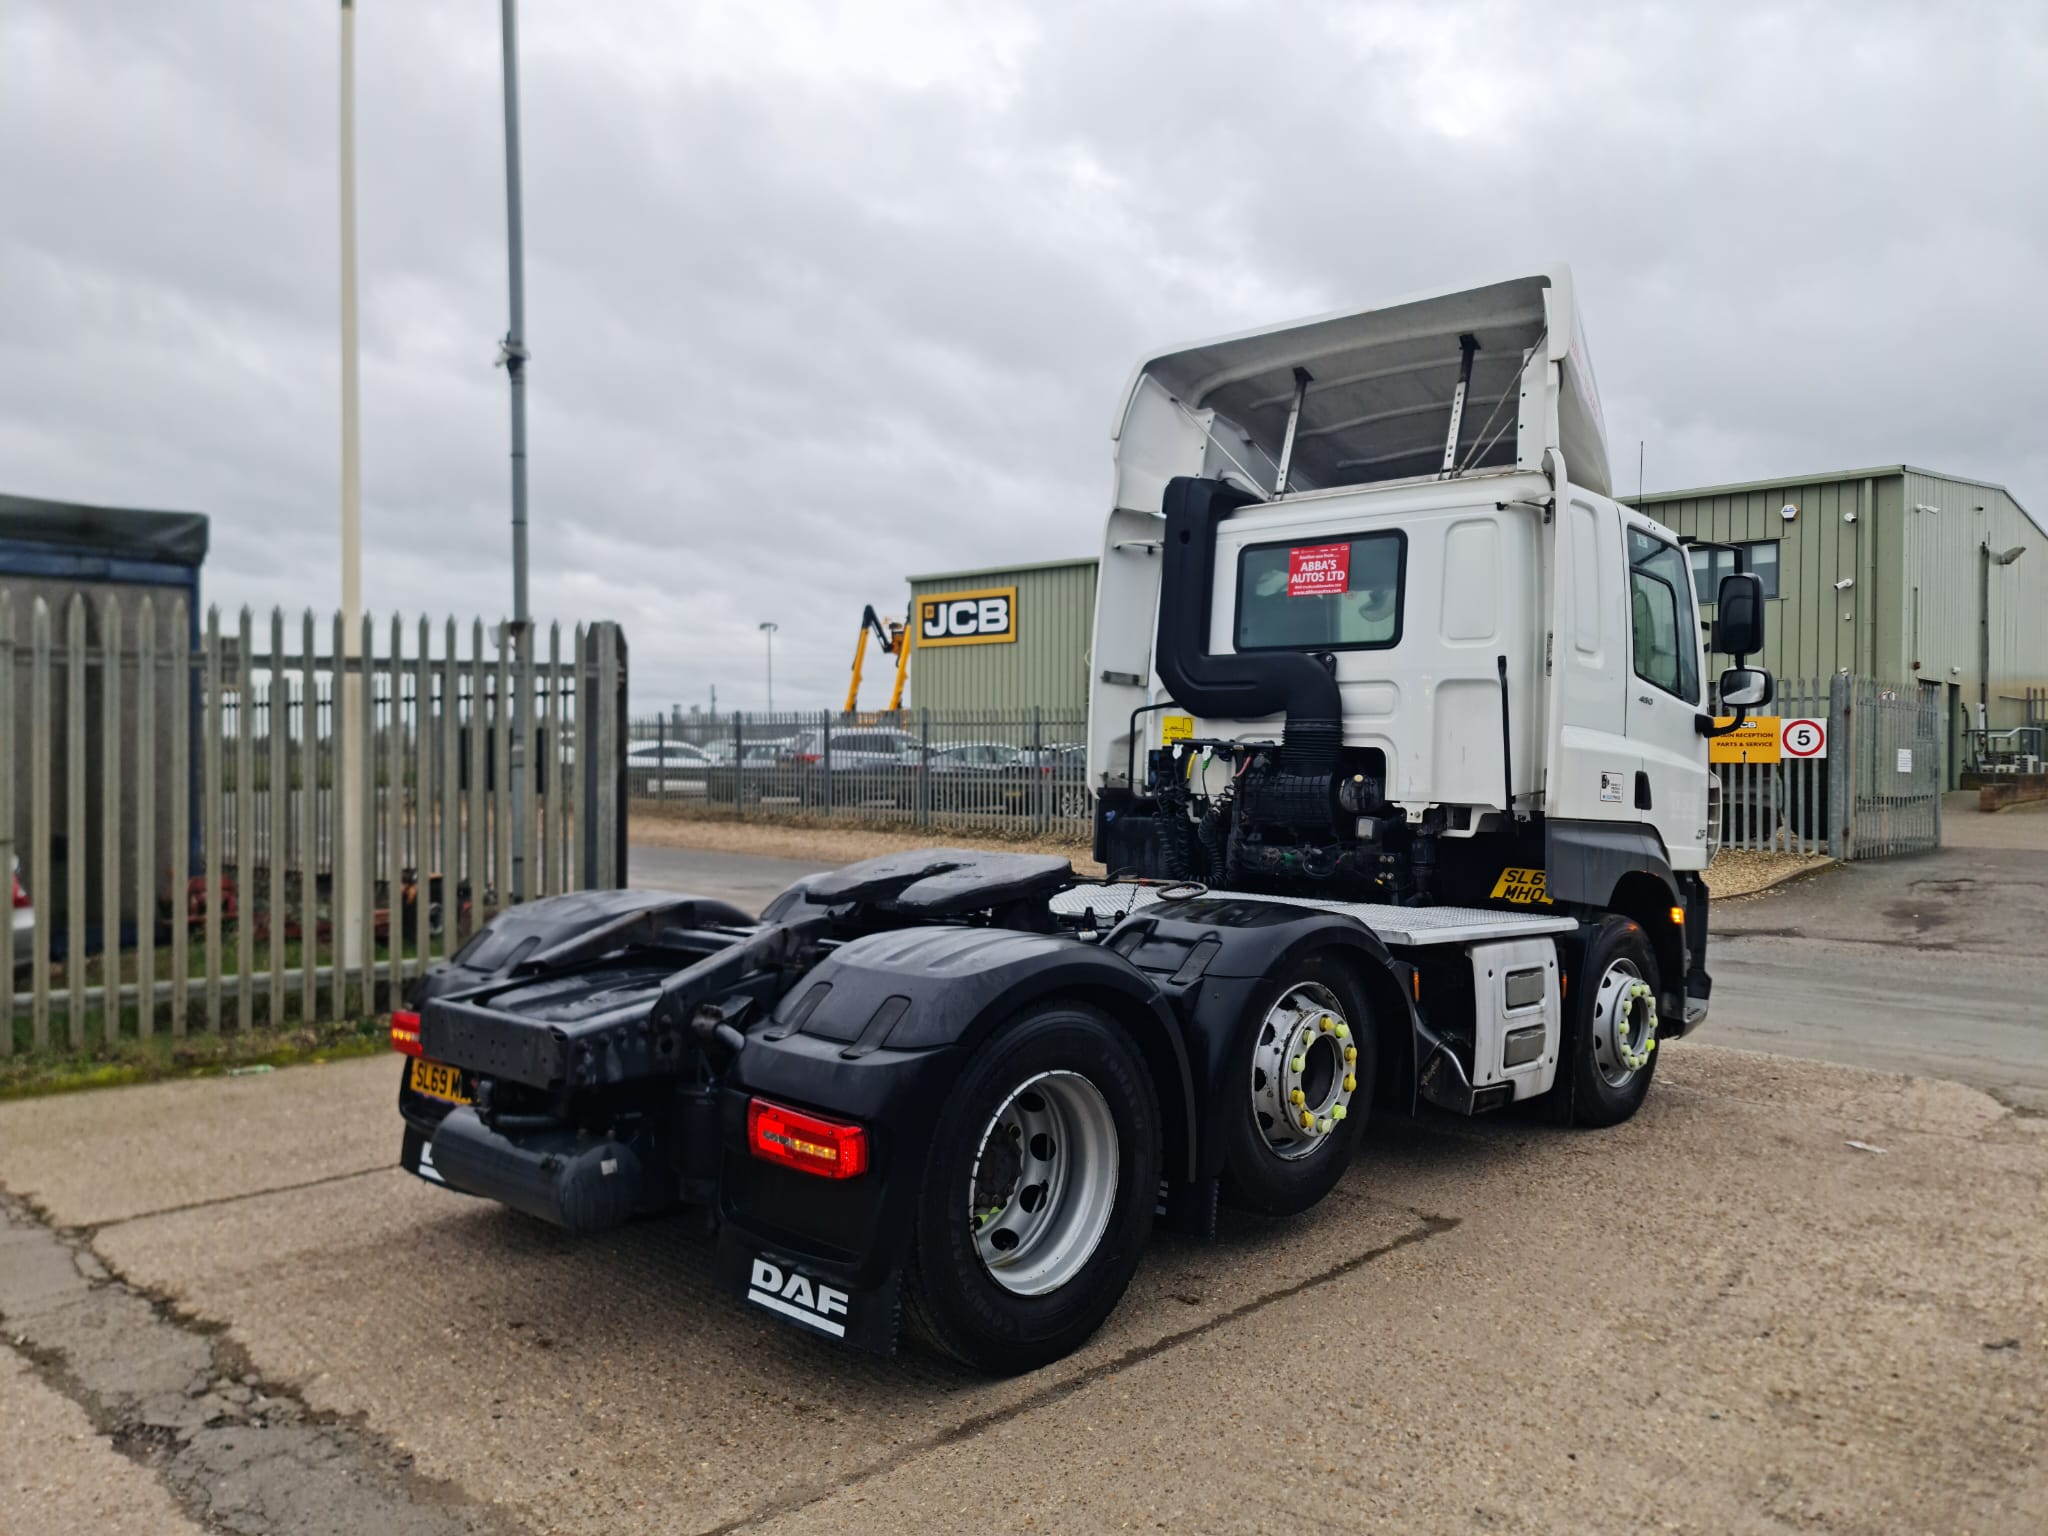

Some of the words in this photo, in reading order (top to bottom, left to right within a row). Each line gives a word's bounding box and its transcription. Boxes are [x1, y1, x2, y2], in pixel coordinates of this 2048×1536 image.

[1300, 559, 1337, 572] ABBA'S
[1291, 571, 1325, 583] AUTOS
[1327, 570, 1346, 582] LTD
[924, 599, 1008, 636] JCB
[1797, 729, 1811, 746] 5
[1504, 869, 1546, 886] SL6
[1503, 884, 1545, 902] MHO
[416, 1063, 449, 1094] SL69
[750, 1258, 849, 1315] DAF
